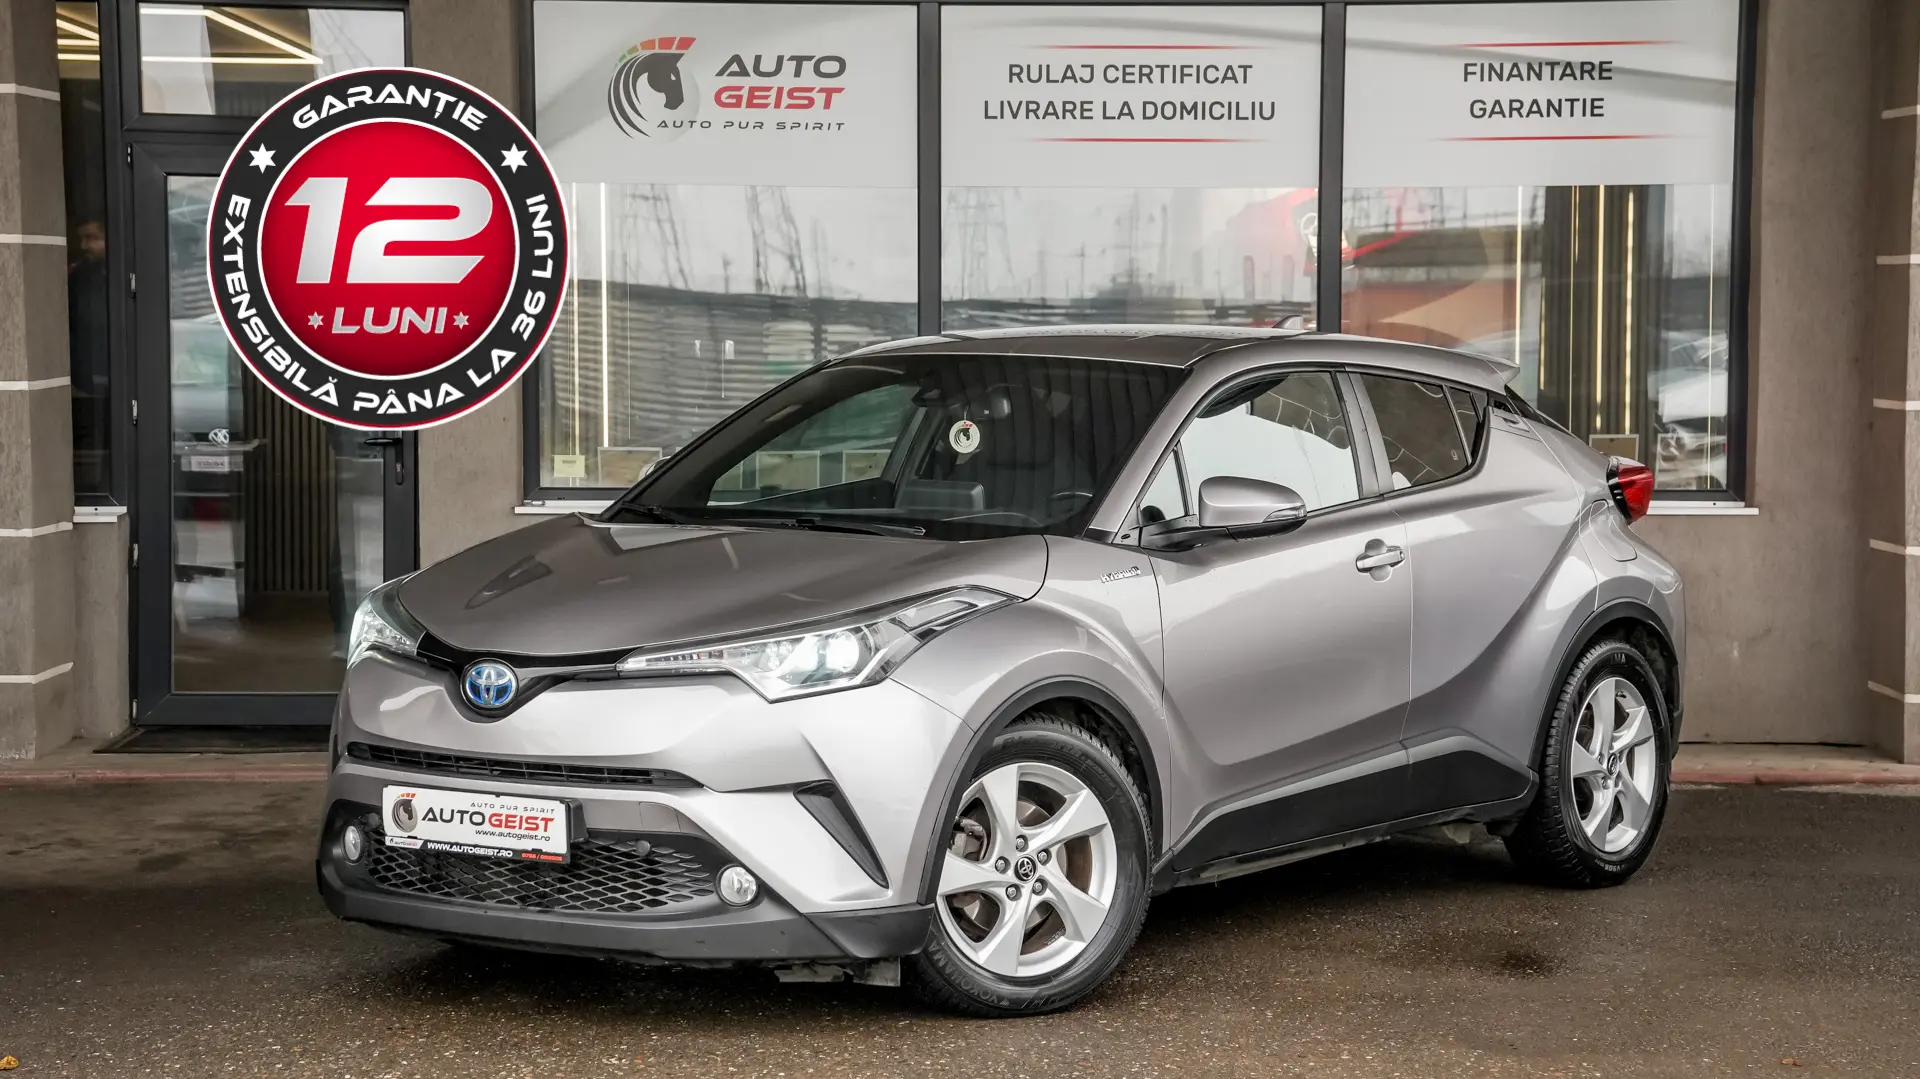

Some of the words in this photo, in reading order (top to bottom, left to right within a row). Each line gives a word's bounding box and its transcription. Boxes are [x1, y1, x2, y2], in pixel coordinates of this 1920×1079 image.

[714, 53, 847, 79] AUTO
[1008, 63, 1095, 84] RULAJ
[1102, 64, 1253, 84] CERTIFICAT
[1463, 60, 1613, 82] FINANTARE
[713, 85, 846, 110] GEIST
[1469, 97, 1605, 119] GARANTIE
[984, 100, 1094, 120] LIVRARE
[1102, 100, 1135, 120] LA
[1142, 101, 1276, 121] DOMICILIU
[656, 119, 712, 129] AUTO
[723, 120, 764, 130] PUR
[775, 121, 846, 131] SPIRIT
[523, 806, 555, 814] SPIRIT
[475, 828, 551, 842] www.autogeist.ro
[427, 841, 513, 858] WWW.AUTOGEIST.RO
